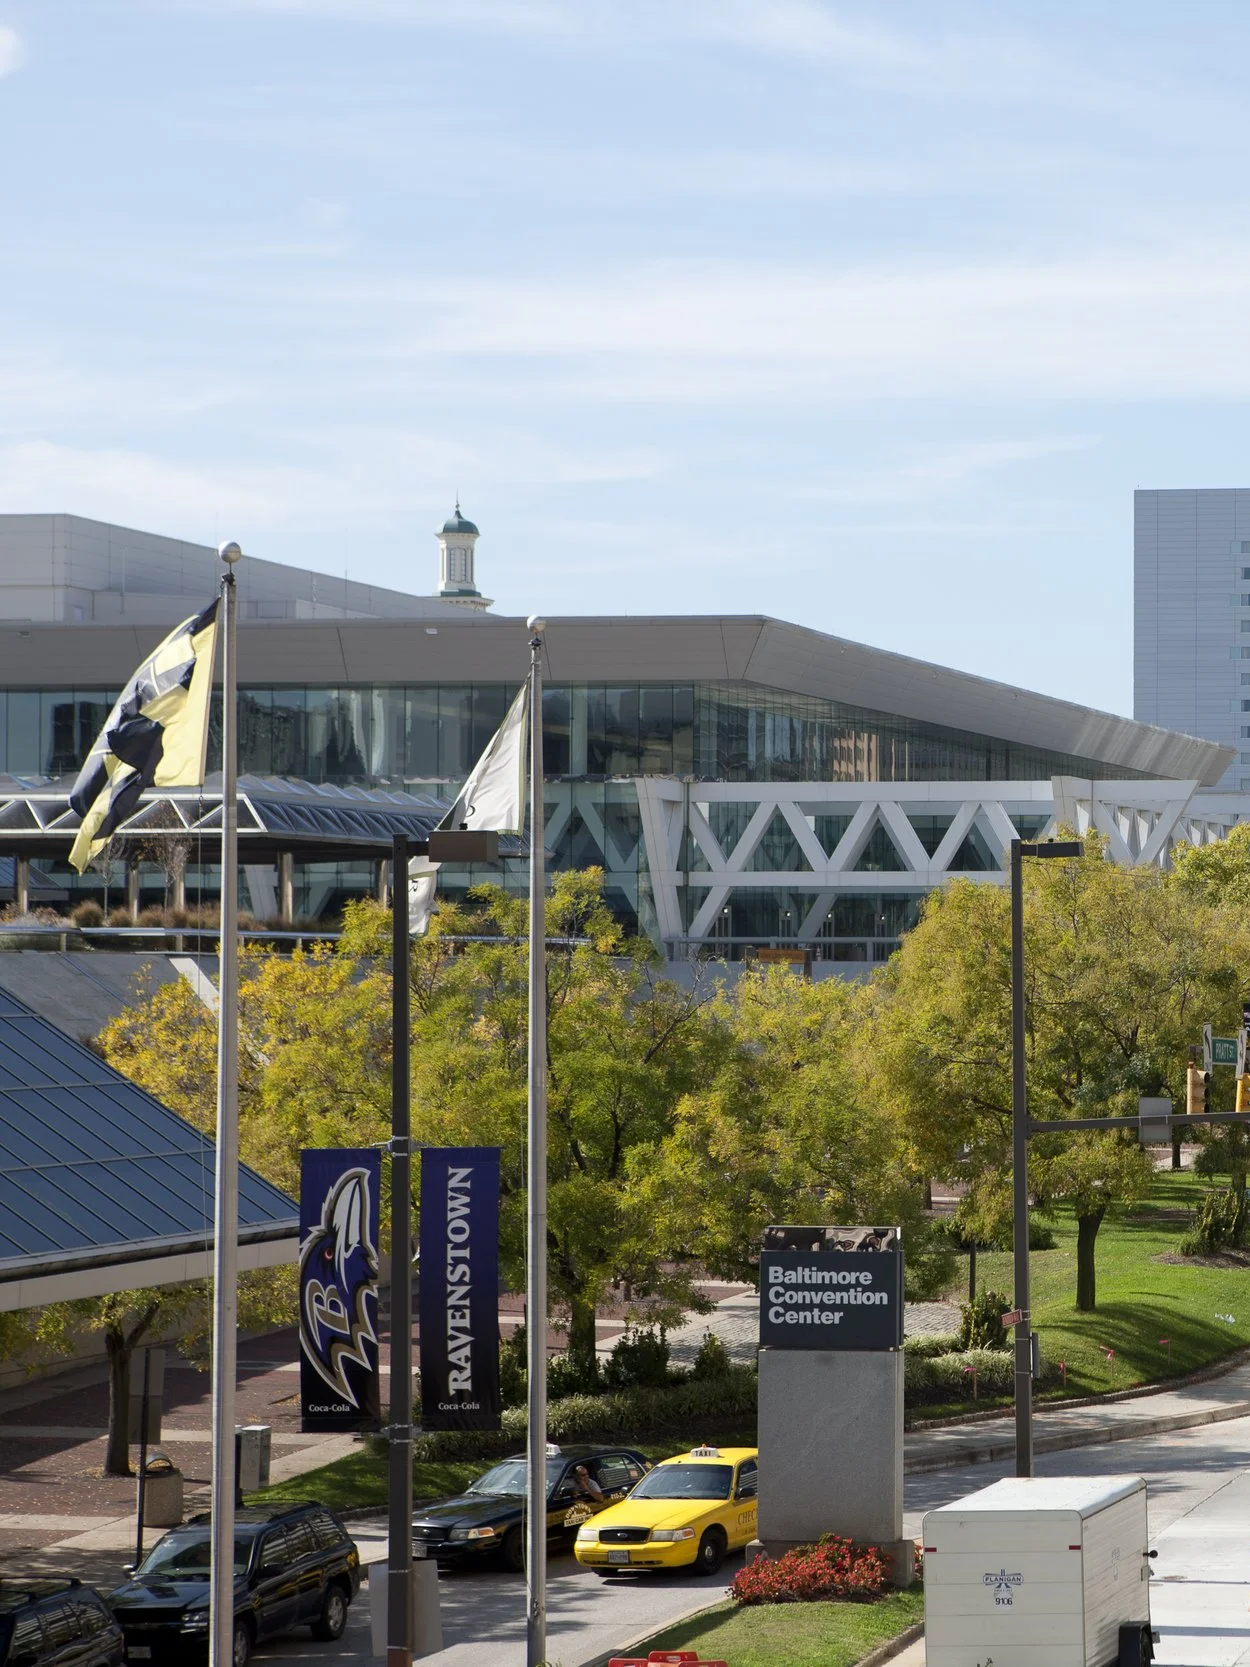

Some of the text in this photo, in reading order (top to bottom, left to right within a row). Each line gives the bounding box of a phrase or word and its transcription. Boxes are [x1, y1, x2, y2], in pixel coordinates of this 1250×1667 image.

[1216, 1042, 1228, 1061] PRATT
[447, 1166, 475, 1396] RAVENSTOWN
[768, 1266, 873, 1285] Baltimore
[768, 1285, 888, 1305] Convention
[768, 1305, 844, 1325] Center
[308, 1402, 350, 1412] Coca-Cola
[438, 1402, 480, 1411] Coca-Cola
[565, 1503, 592, 1519] DOWNTOWN
[985, 1575, 1022, 1583] FLANIGAN
[995, 1597, 1013, 1606] 9106
